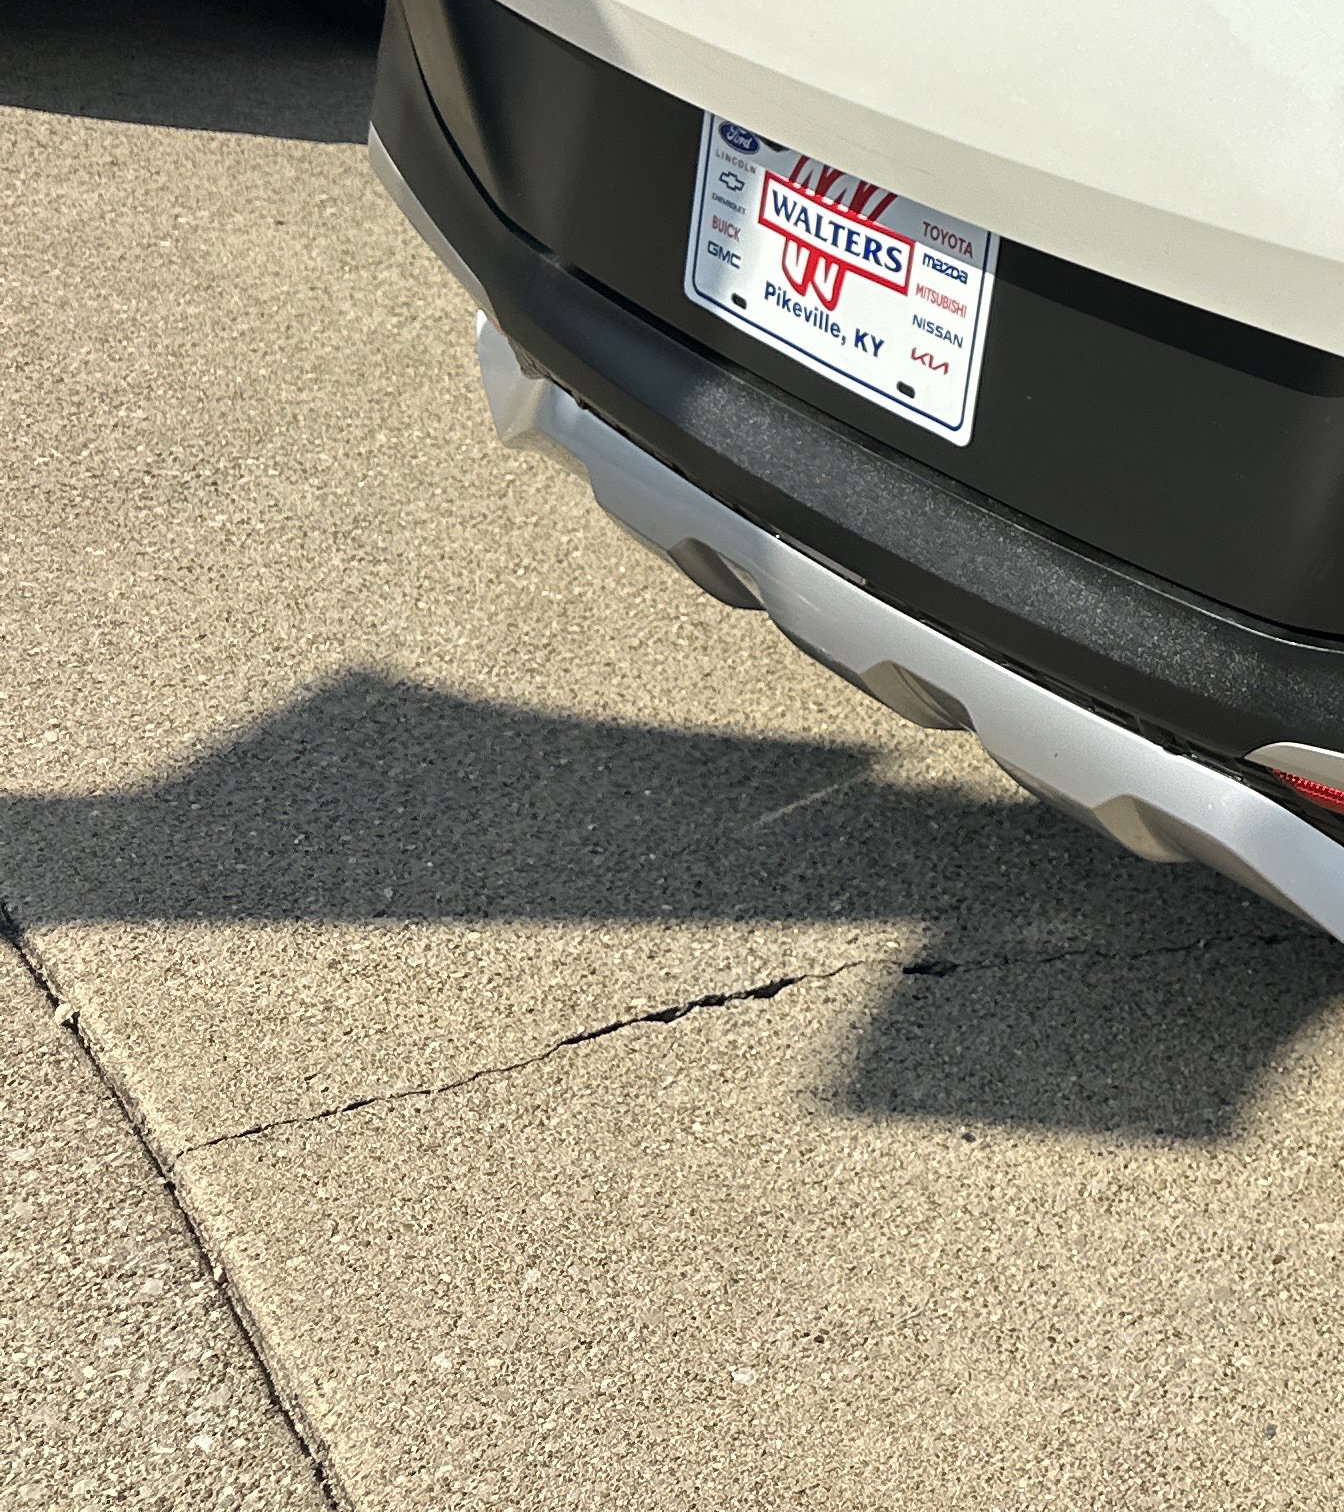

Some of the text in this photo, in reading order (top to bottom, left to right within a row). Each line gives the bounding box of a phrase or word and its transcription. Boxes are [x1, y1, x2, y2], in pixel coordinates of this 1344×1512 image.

[716, 149, 757, 174] LINCOLN
[711, 192, 747, 214] CHEVROLET
[711, 215, 741, 242] BUICK
[772, 188, 903, 274] WALTERS
[922, 221, 974, 259] TOYOTA
[707, 240, 742, 269] GMC
[915, 282, 967, 319] MITSUBISHI
[764, 279, 885, 359] Pikeville, KY
[912, 314, 964, 349] NISSAN
[910, 347, 950, 376] KIA
